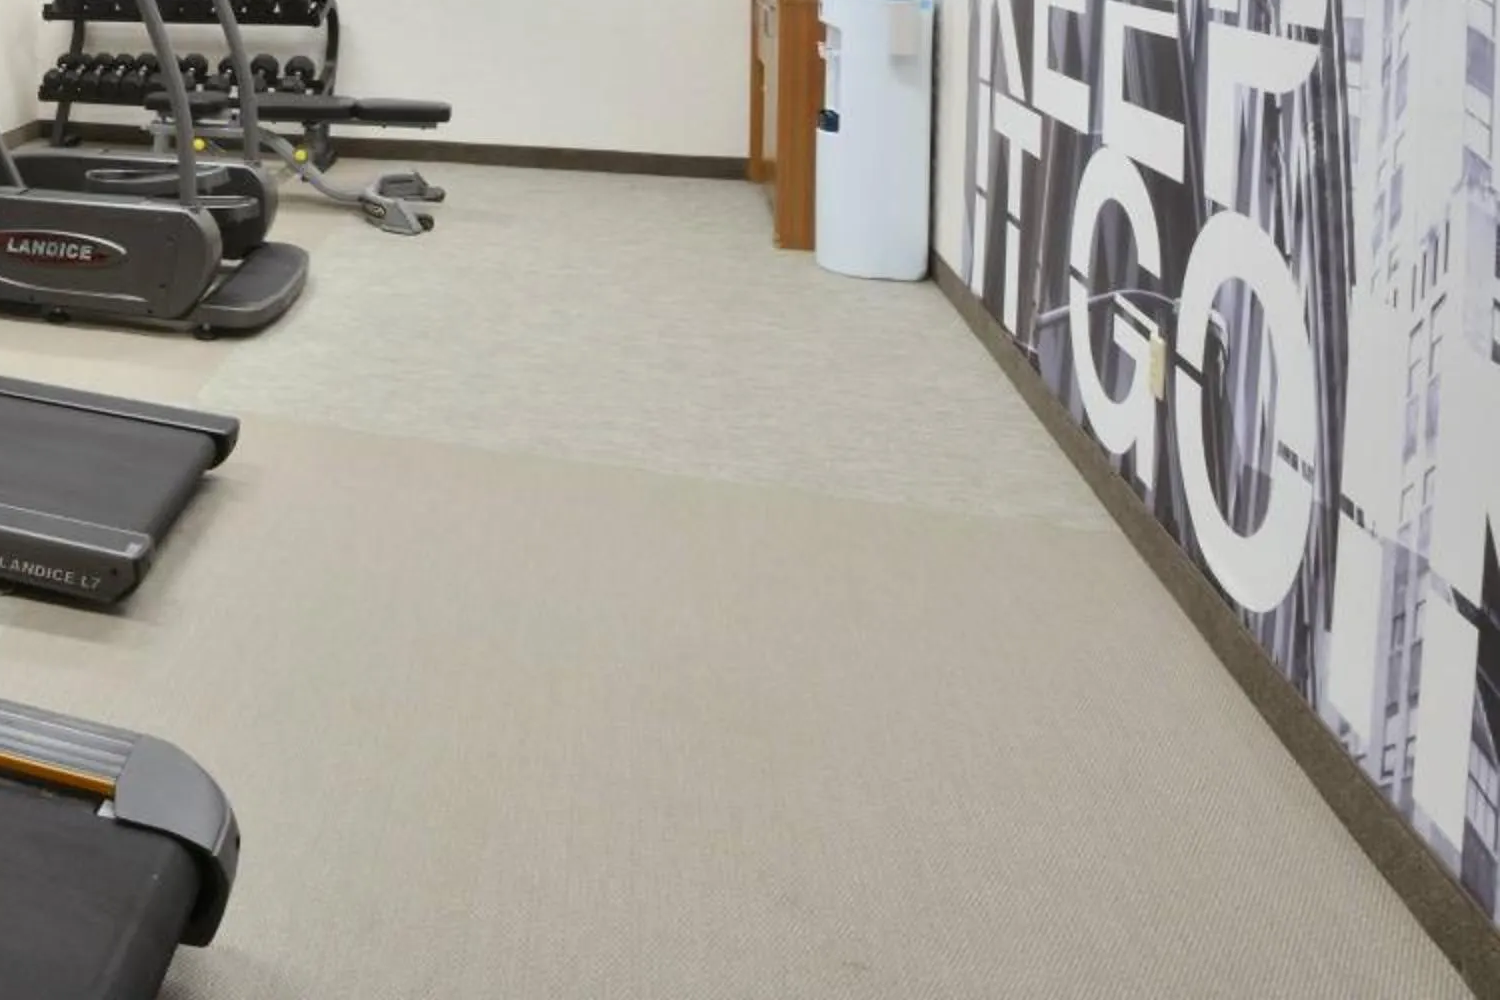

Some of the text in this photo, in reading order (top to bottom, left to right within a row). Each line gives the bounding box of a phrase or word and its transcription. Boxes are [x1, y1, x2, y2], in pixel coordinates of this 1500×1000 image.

[966, 80, 1042, 336] IT
[6, 237, 94, 261] LANDICE
[81, 575, 101, 589] L7
